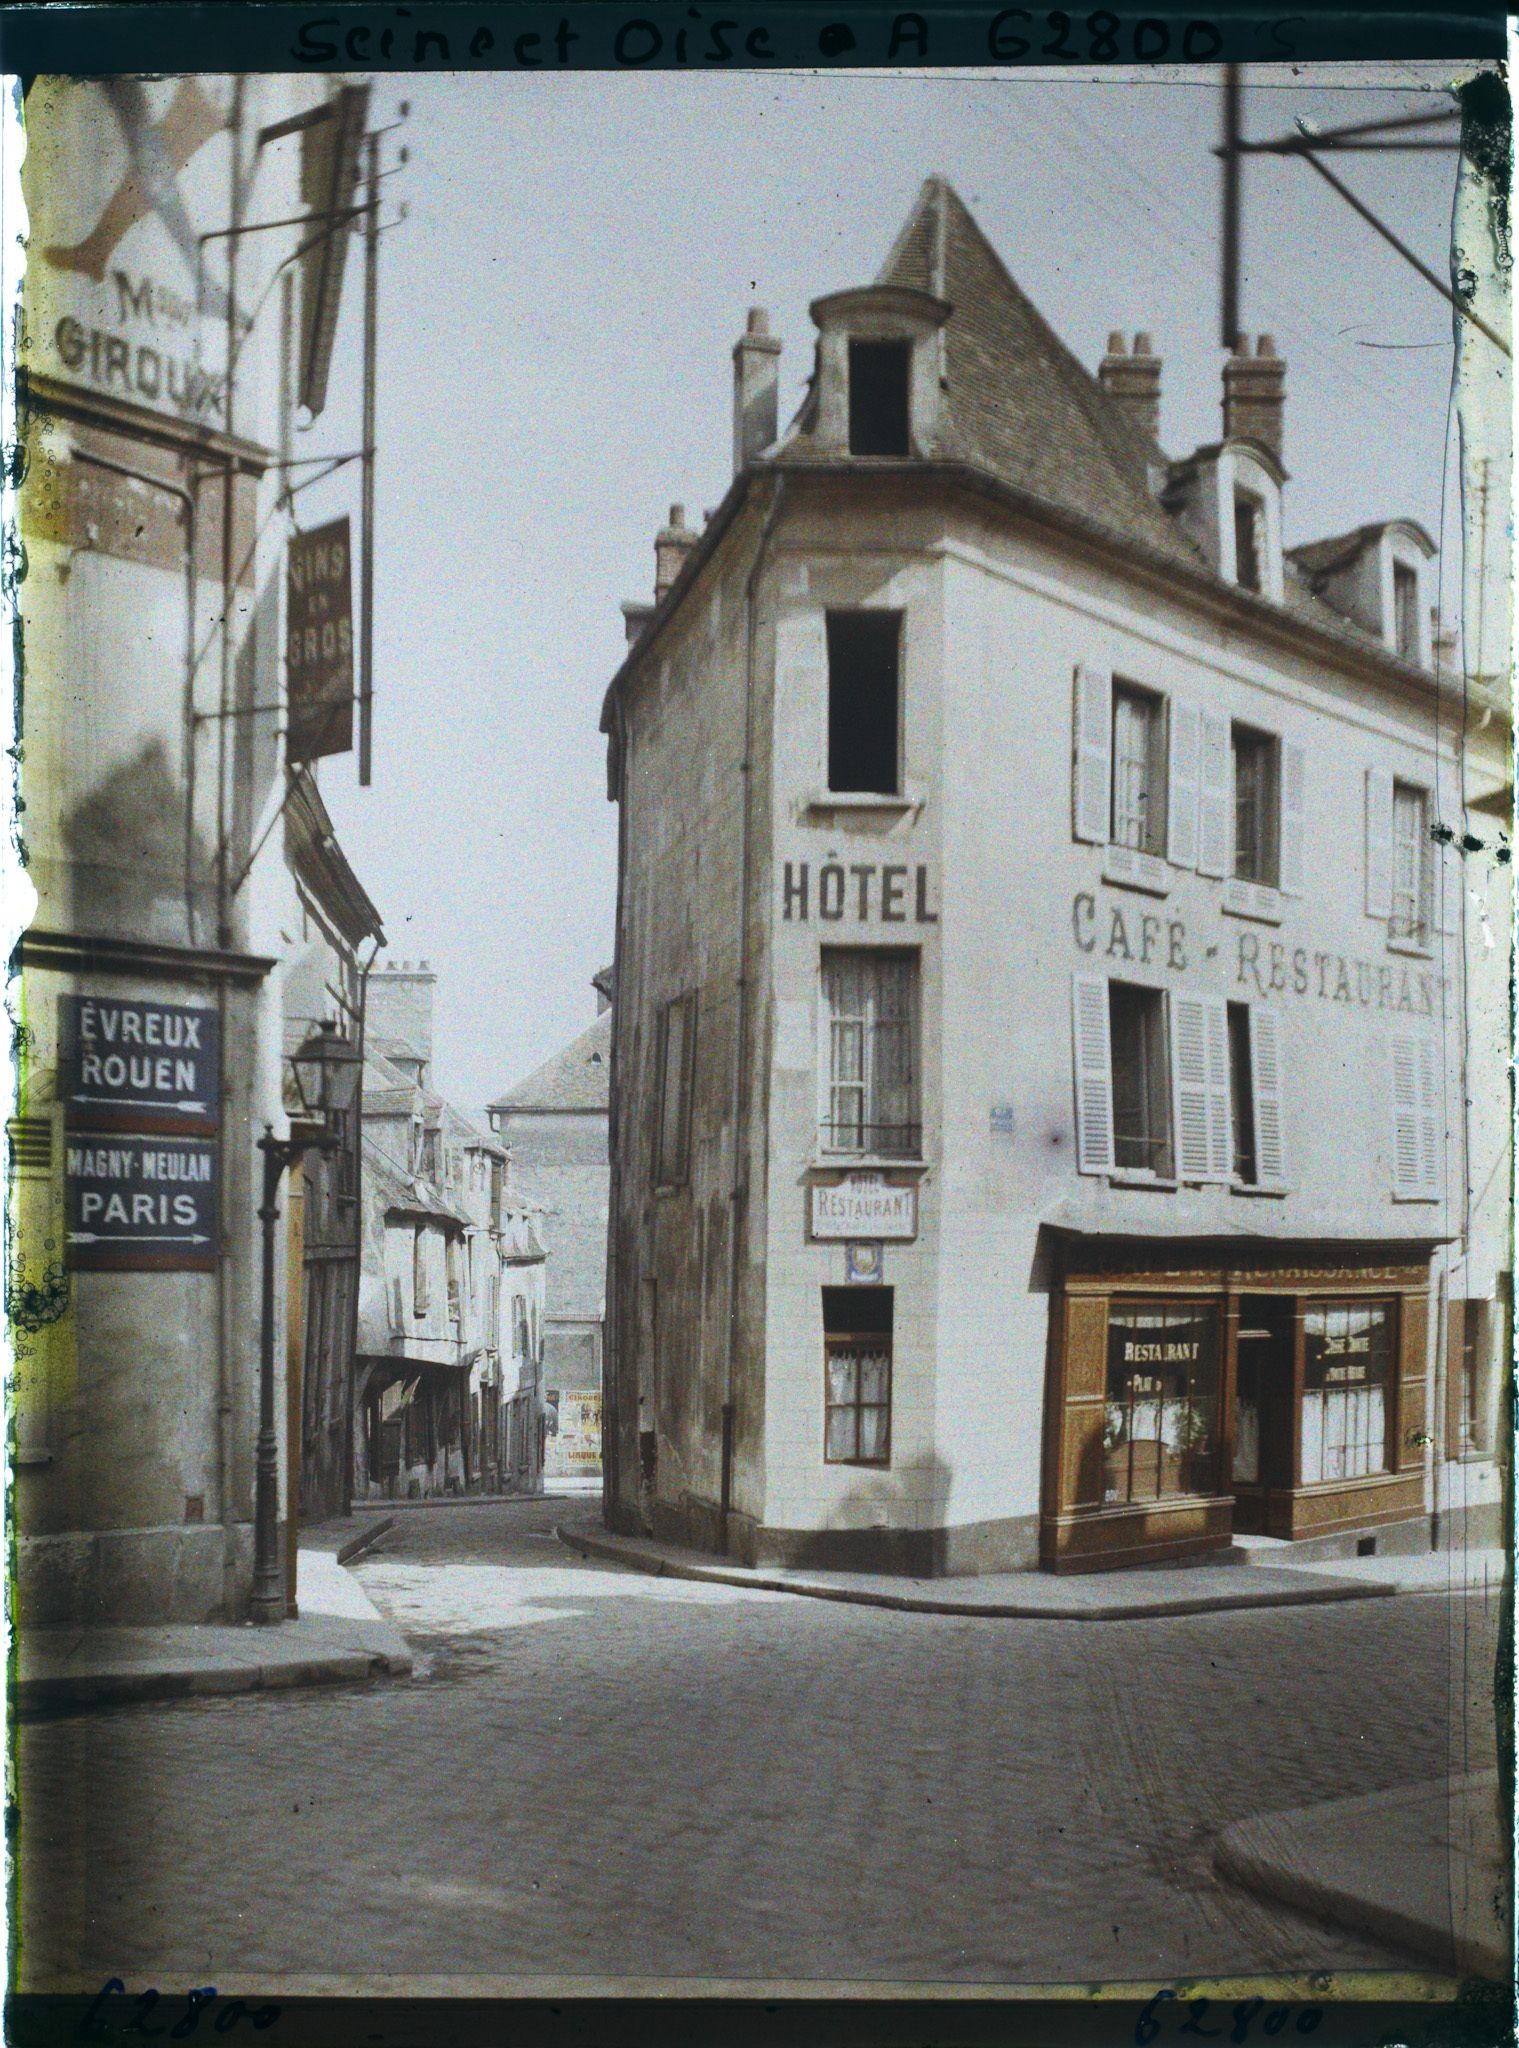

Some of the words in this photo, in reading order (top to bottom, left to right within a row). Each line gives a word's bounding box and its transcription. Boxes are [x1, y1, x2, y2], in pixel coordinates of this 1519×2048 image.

[614, 7, 776, 66] Oise
[987, 9, 1224, 61] 62800
[783, 850, 939, 924] HÔTEL
[80, 1001, 201, 1049] ÉVREUX
[81, 1053, 196, 1092] ROUEN
[81, 1192, 198, 1226] PARIS
[818, 1190, 912, 1217] RESTAURANT
[1134, 1989, 1323, 2046] 62800
